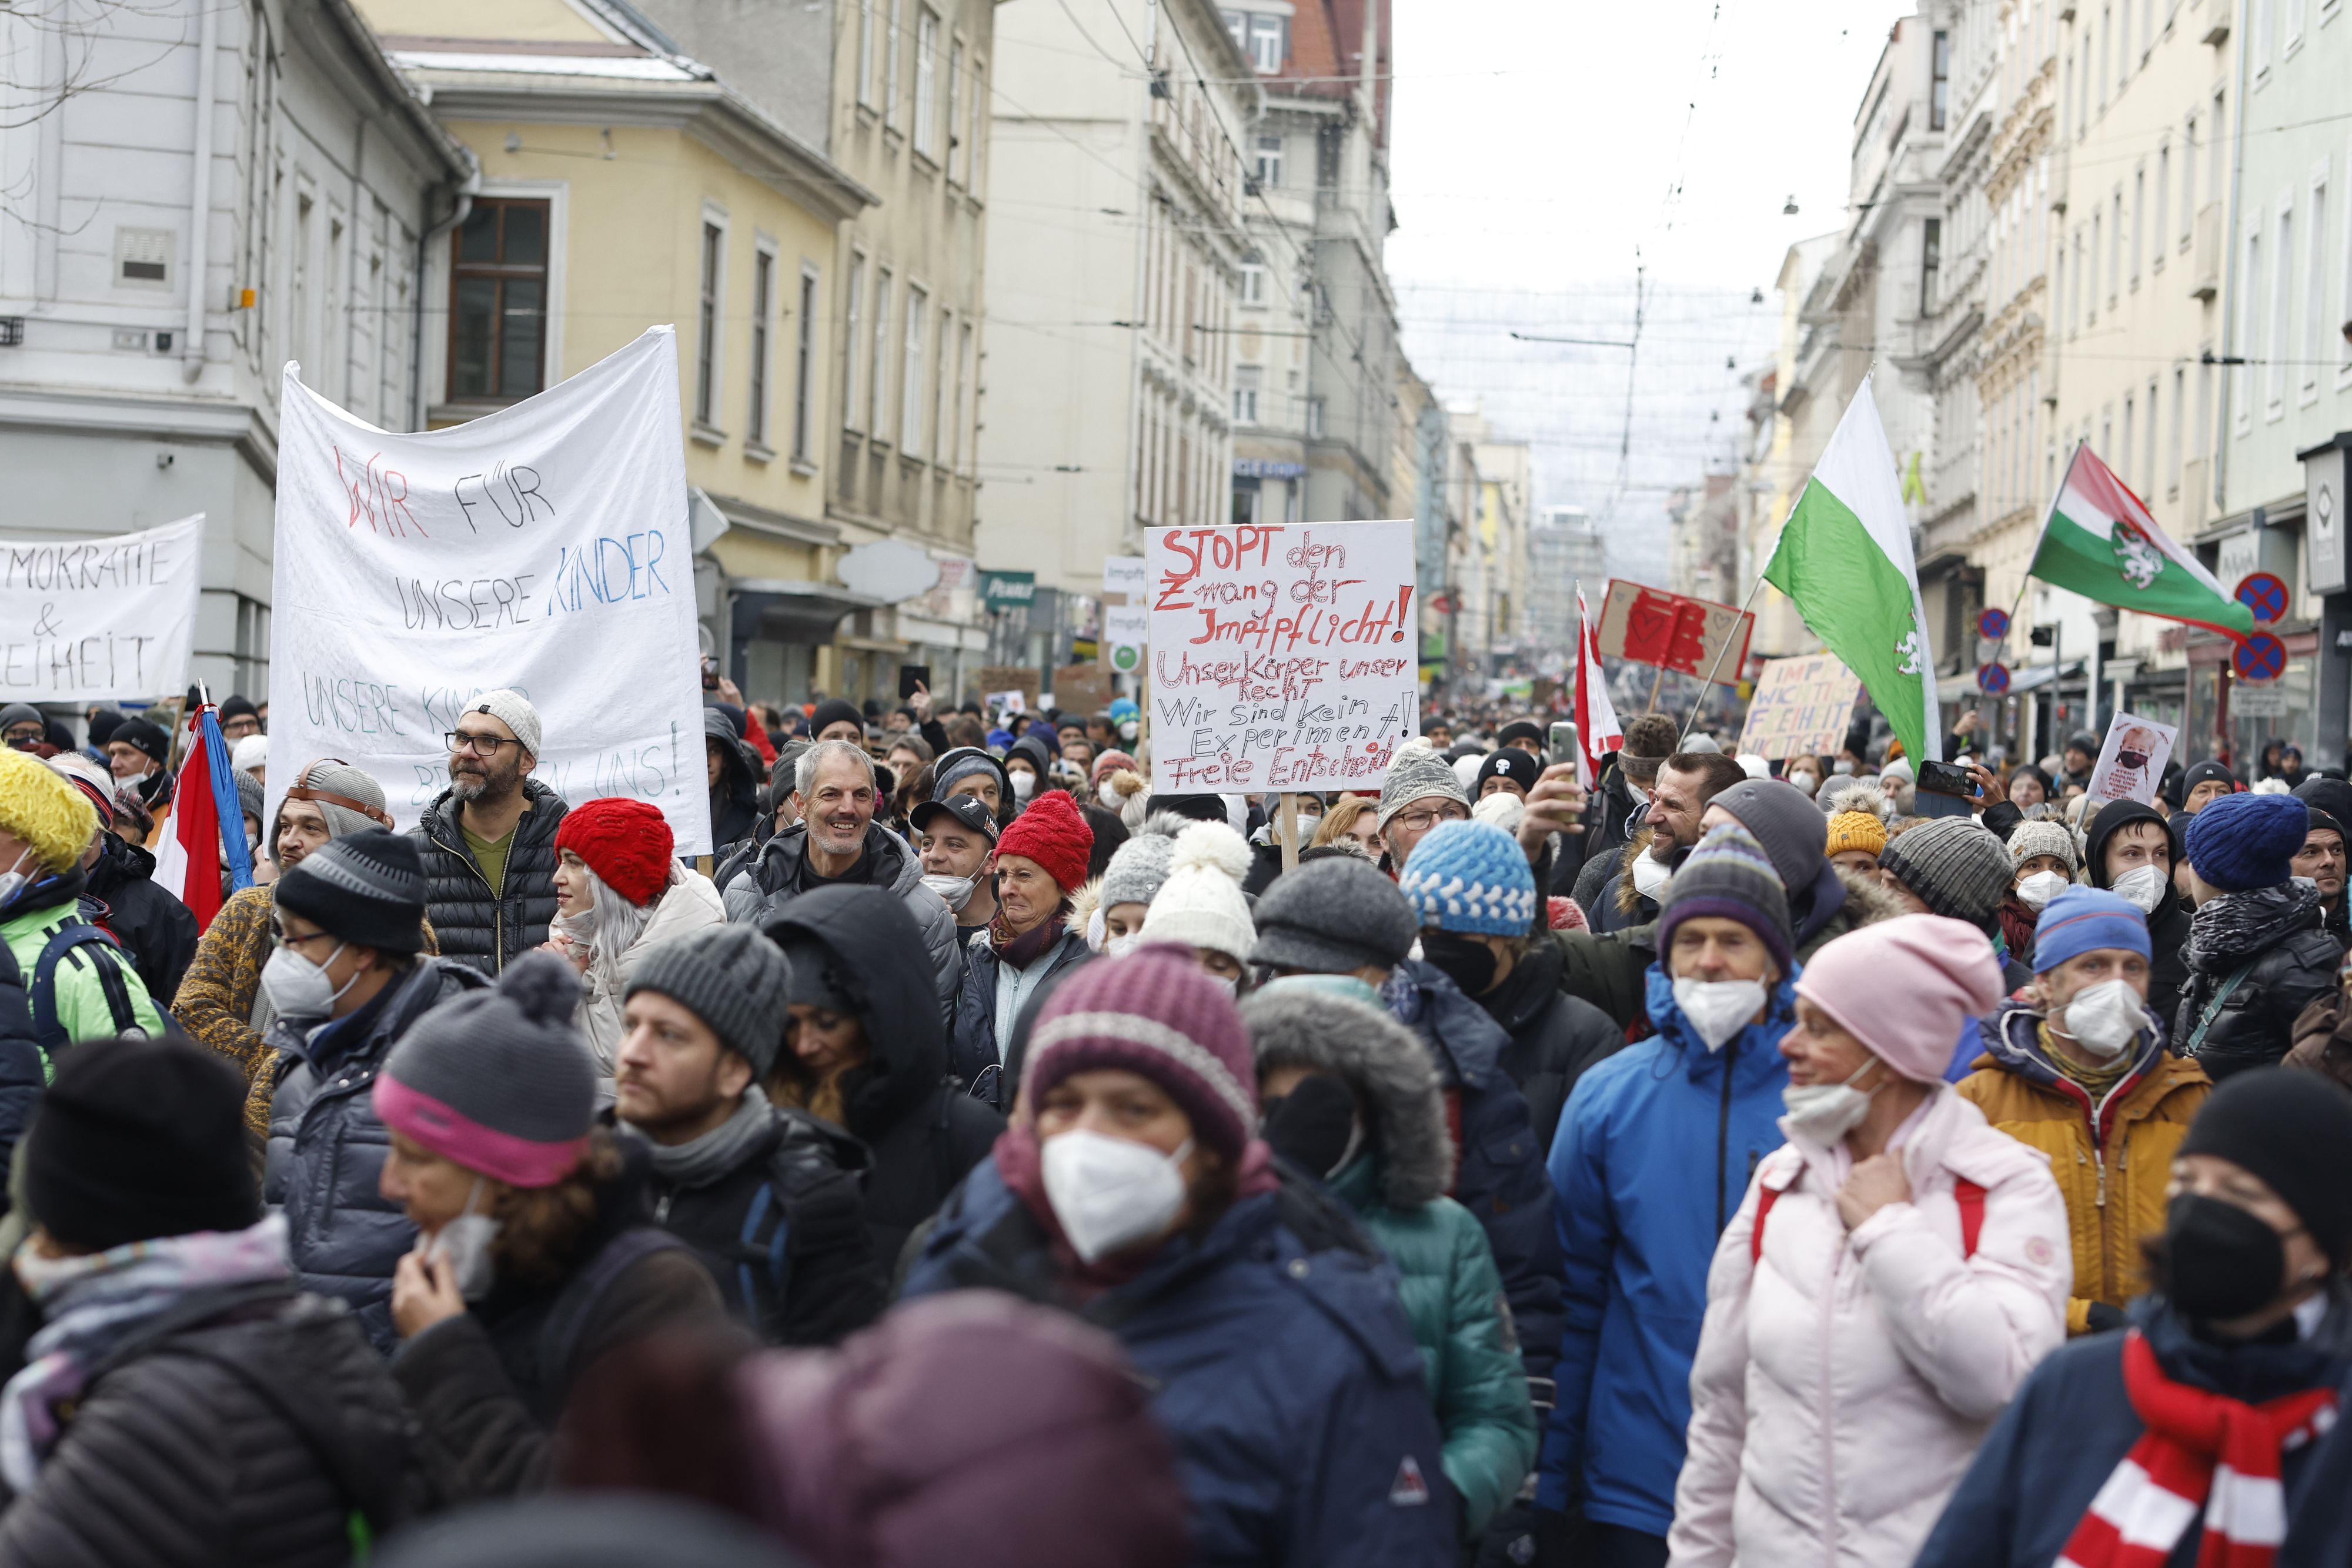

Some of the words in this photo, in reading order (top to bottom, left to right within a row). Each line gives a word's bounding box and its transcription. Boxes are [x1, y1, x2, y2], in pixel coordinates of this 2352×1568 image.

[333, 446, 429, 537] WIR
[455, 459, 555, 534] FÜR
[0, 534, 175, 590] MOKRATIE
[1162, 525, 1285, 579] STOPT
[1287, 531, 1346, 570] den
[396, 574, 534, 630] UNSERE
[548, 530, 670, 616] KINDER
[1154, 578, 1278, 620] Zwang
[1290, 569, 1367, 604] der
[34, 601, 63, 637] &
[0, 630, 155, 691] EIHEIT
[1339, 658, 1408, 681] unser
[303, 671, 409, 736] UNSERE
[1158, 696, 1217, 727] Wir
[1191, 691, 1414, 758] Experiment!
[1747, 701, 1851, 735] FREIHEIT
[1163, 753, 1254, 788] Freie
[1267, 735, 1394, 786] Entscheid
